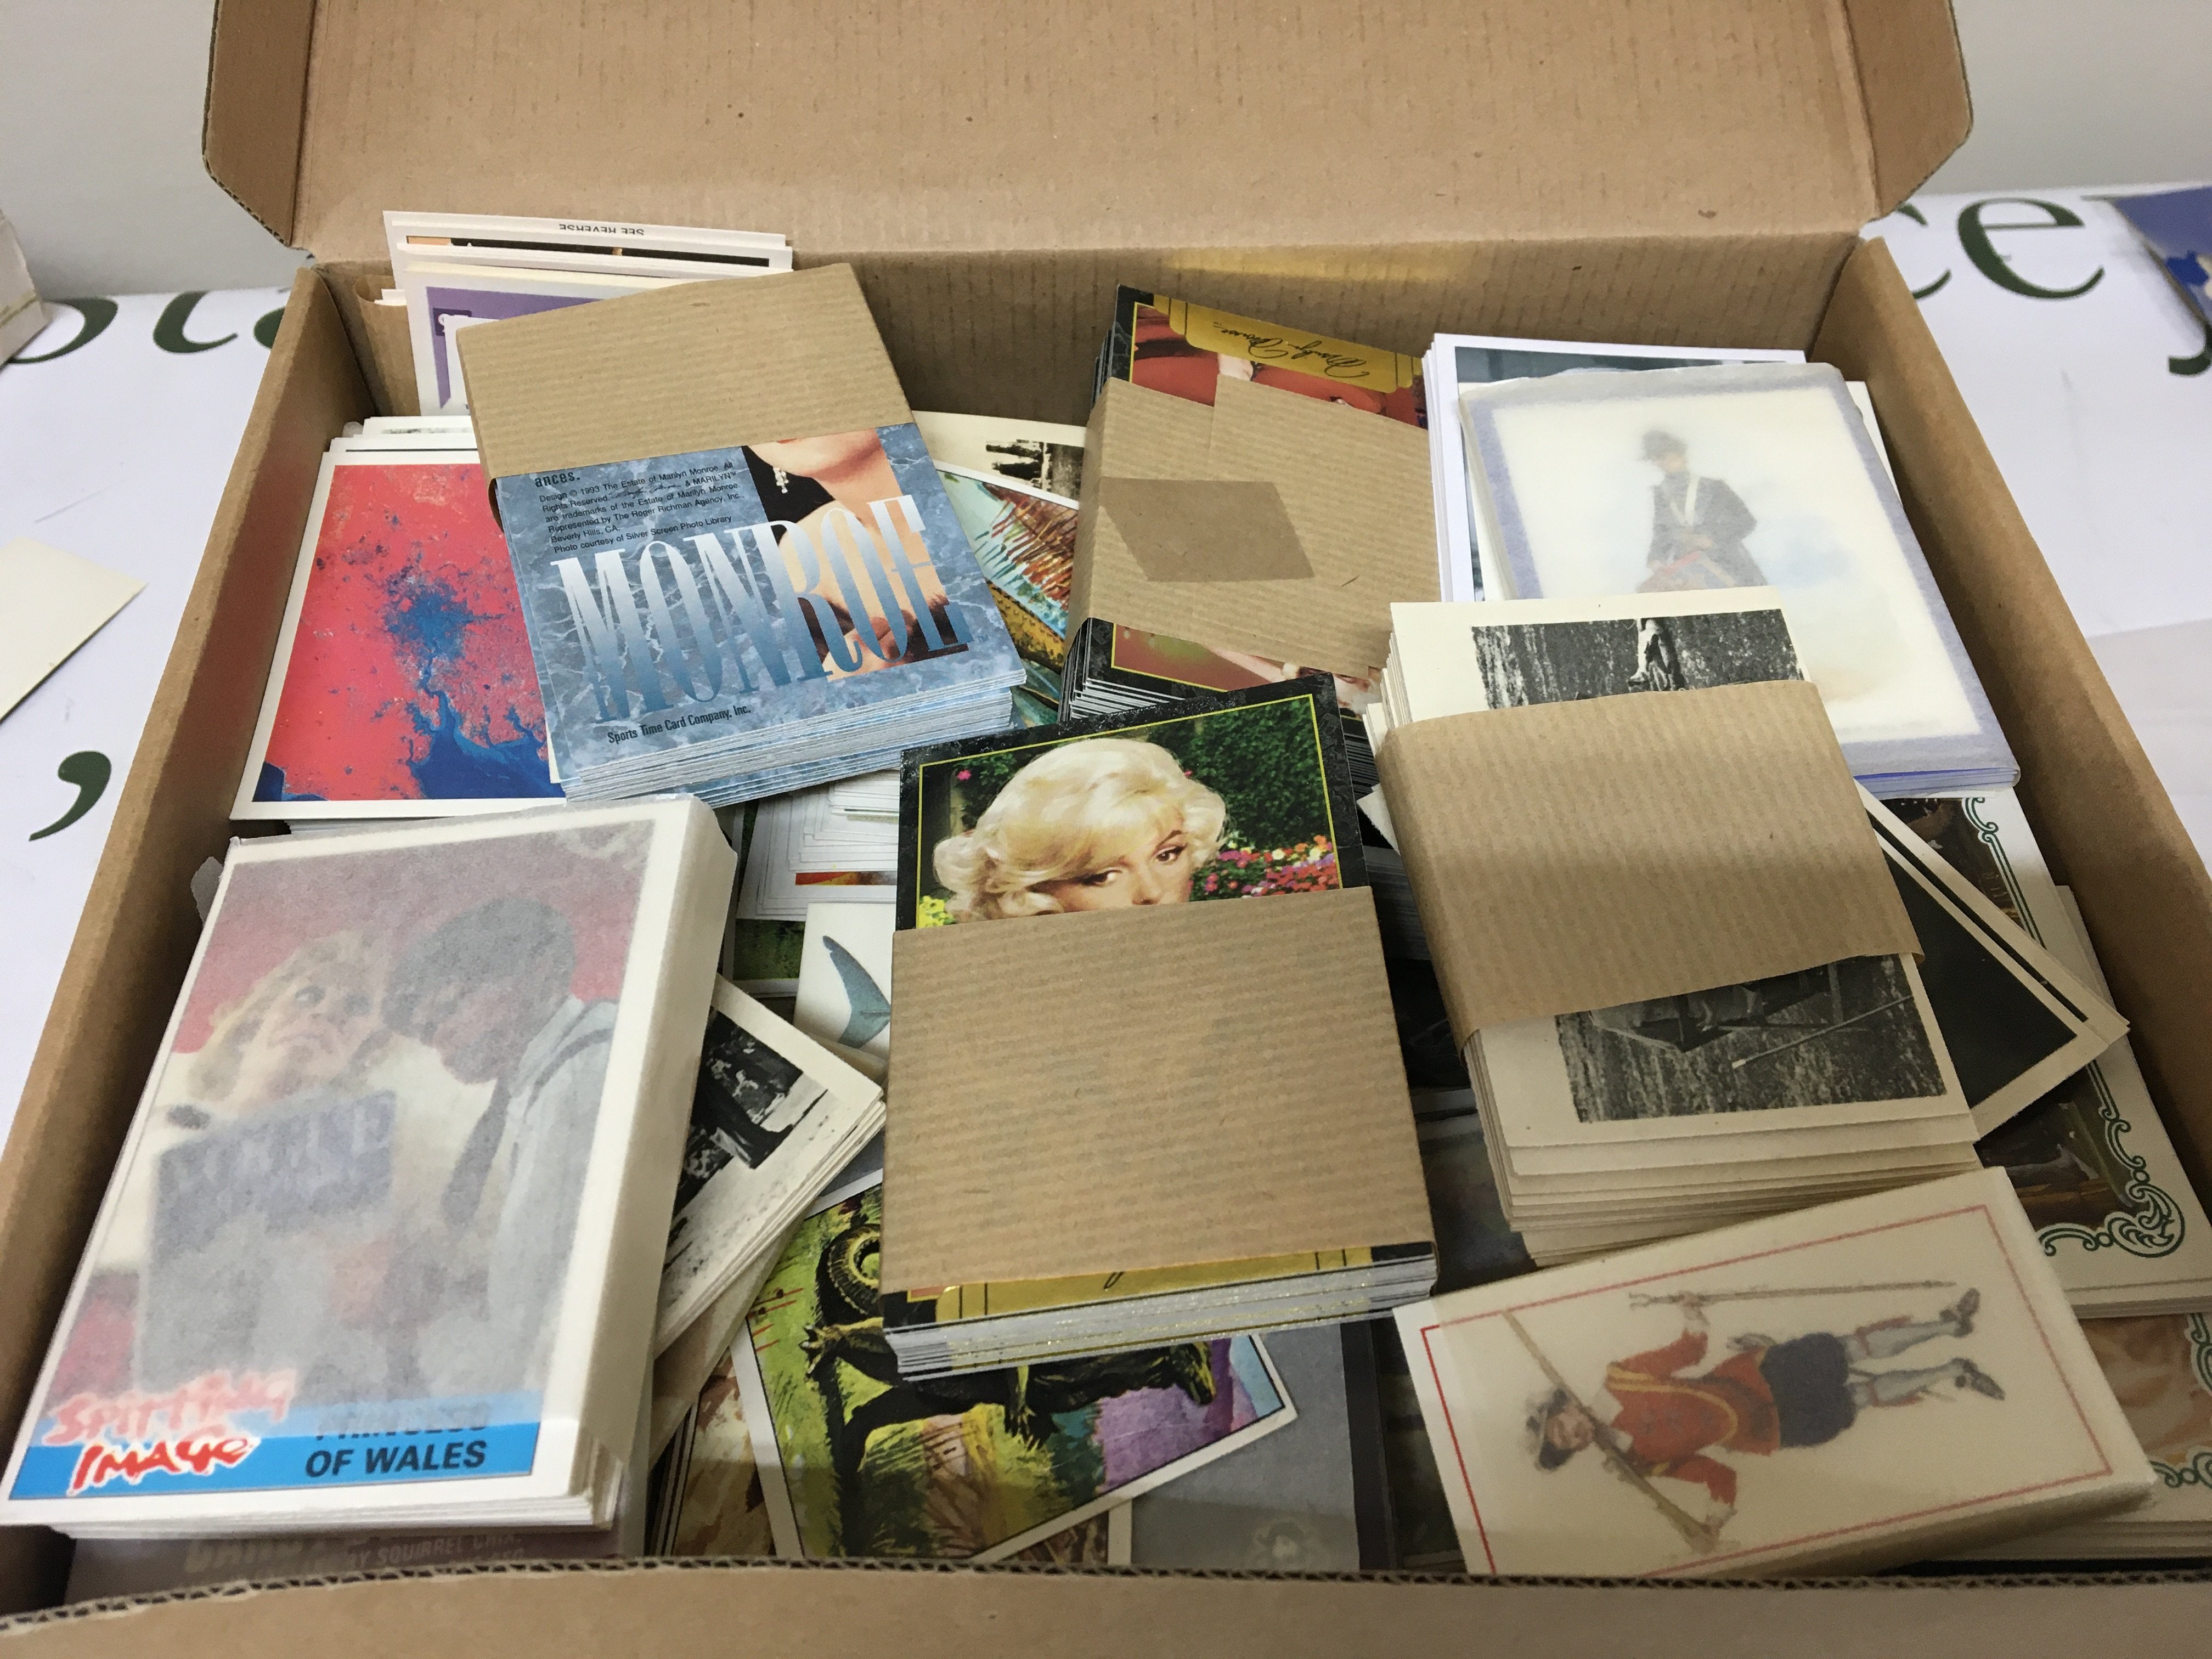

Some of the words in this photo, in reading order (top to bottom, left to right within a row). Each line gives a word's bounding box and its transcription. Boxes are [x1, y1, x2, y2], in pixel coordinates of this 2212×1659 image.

[534, 471, 581, 488] ances.
[539, 492, 568, 503] Design
[580, 485, 600, 495] 1993
[602, 483, 618, 491] The
[620, 478, 646, 488] Estate
[658, 470, 687, 481] Marilyn
[541, 502, 568, 513] Rights
[545, 514, 558, 523] are
[562, 505, 607, 520] trademarks
[610, 503, 618, 511] of
[621, 499, 635, 508] the
[637, 495, 663, 506] Estate
[667, 493, 675, 501] of
[677, 487, 706, 499] Marilyn
[548, 517, 600, 534] Represented
[601, 515, 611, 524] by
[613, 512, 629, 521] The
[631, 506, 656, 518] Roger
[658, 500, 693, 513] Richman
[550, 532, 582, 544] Beverly
[553, 544, 578, 554] Photo
[579, 535, 614, 549] courtesy
[616, 534, 624, 542] of
[625, 529, 648, 540] Silver
[650, 523, 679, 535] Screen
[680, 519, 704, 530] Photo
[704, 515, 732, 526] Library
[550, 494, 974, 723] MONROE
[607, 728, 638, 745] Sports
[639, 723, 663, 737] Time
[664, 715, 687, 731] Card
[733, 704, 752, 716] Inc.
[304, 1449, 355, 1479] OF
[364, 1439, 488, 1476] WALES
